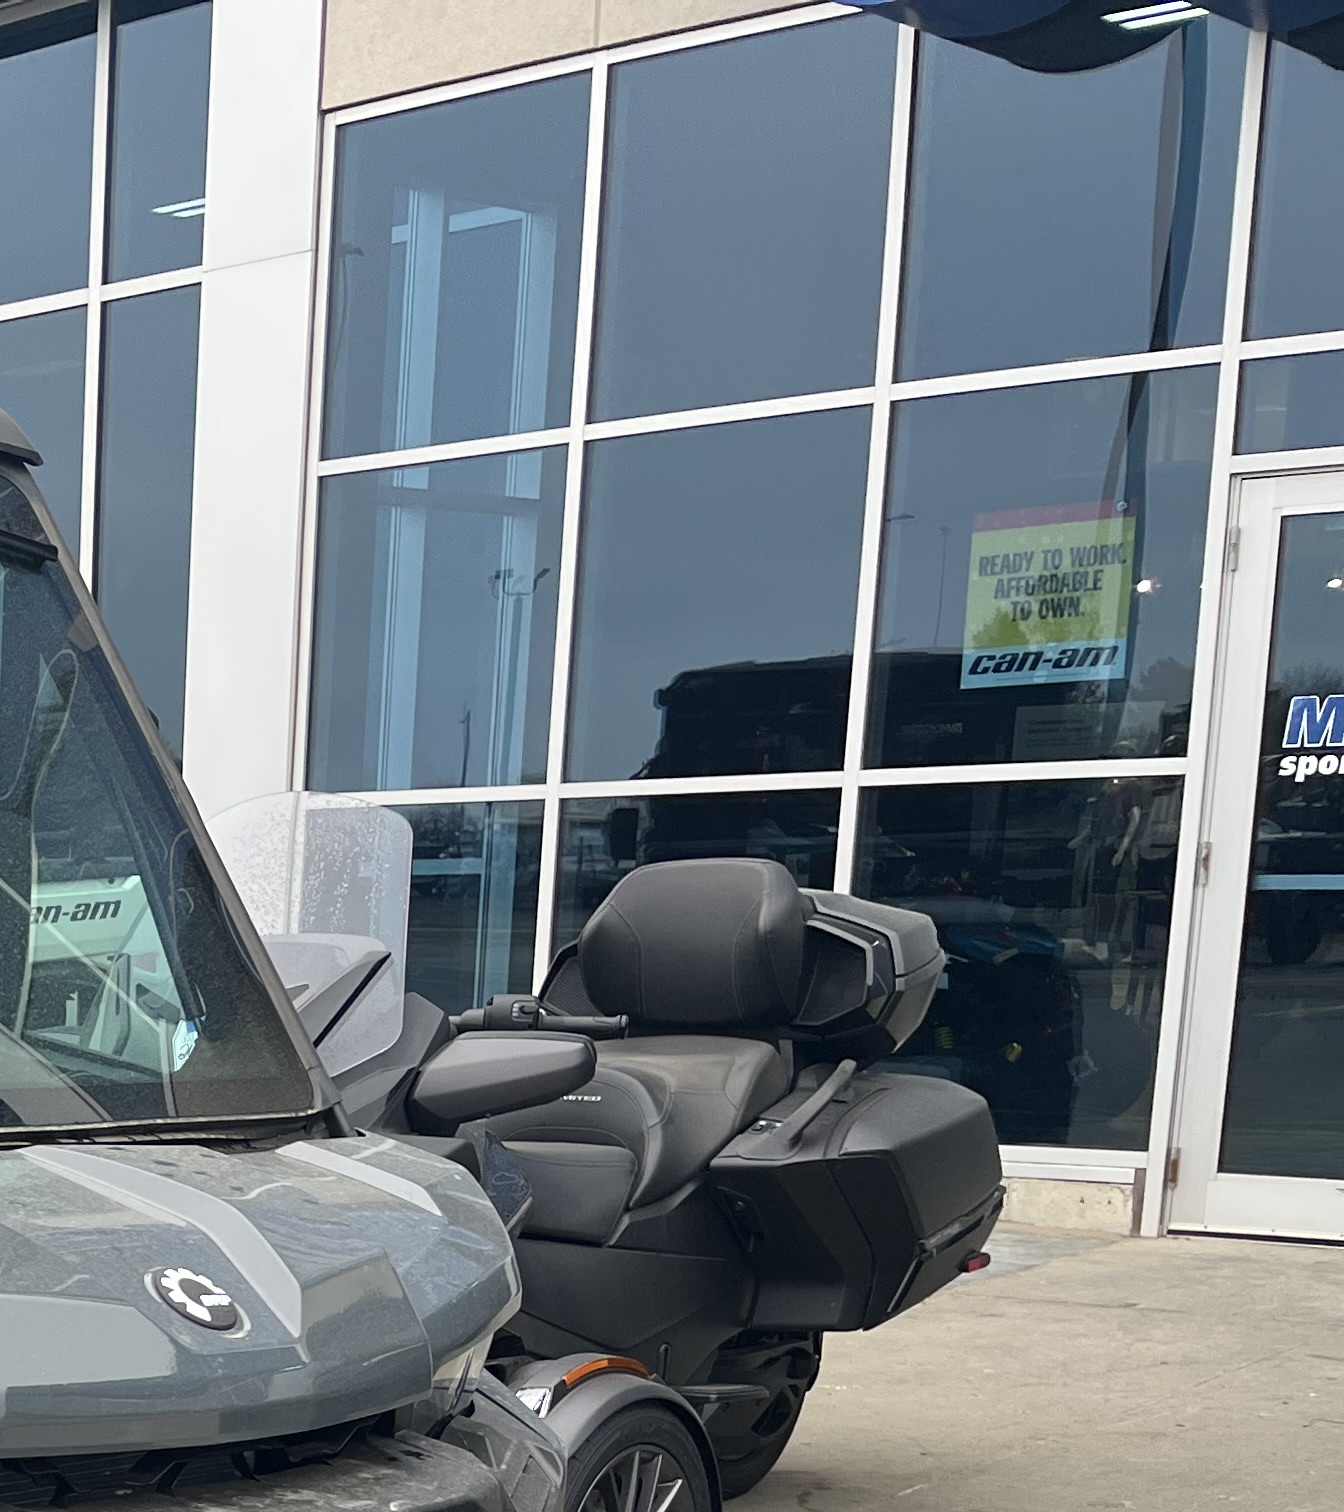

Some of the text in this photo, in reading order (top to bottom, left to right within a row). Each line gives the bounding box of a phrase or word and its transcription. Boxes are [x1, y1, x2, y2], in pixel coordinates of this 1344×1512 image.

[979, 543, 1127, 578] READY TO WORK.
[993, 570, 1104, 600] AFFORDABLE
[1010, 597, 1086, 622] TO OWN.
[967, 644, 1119, 677] can-am
